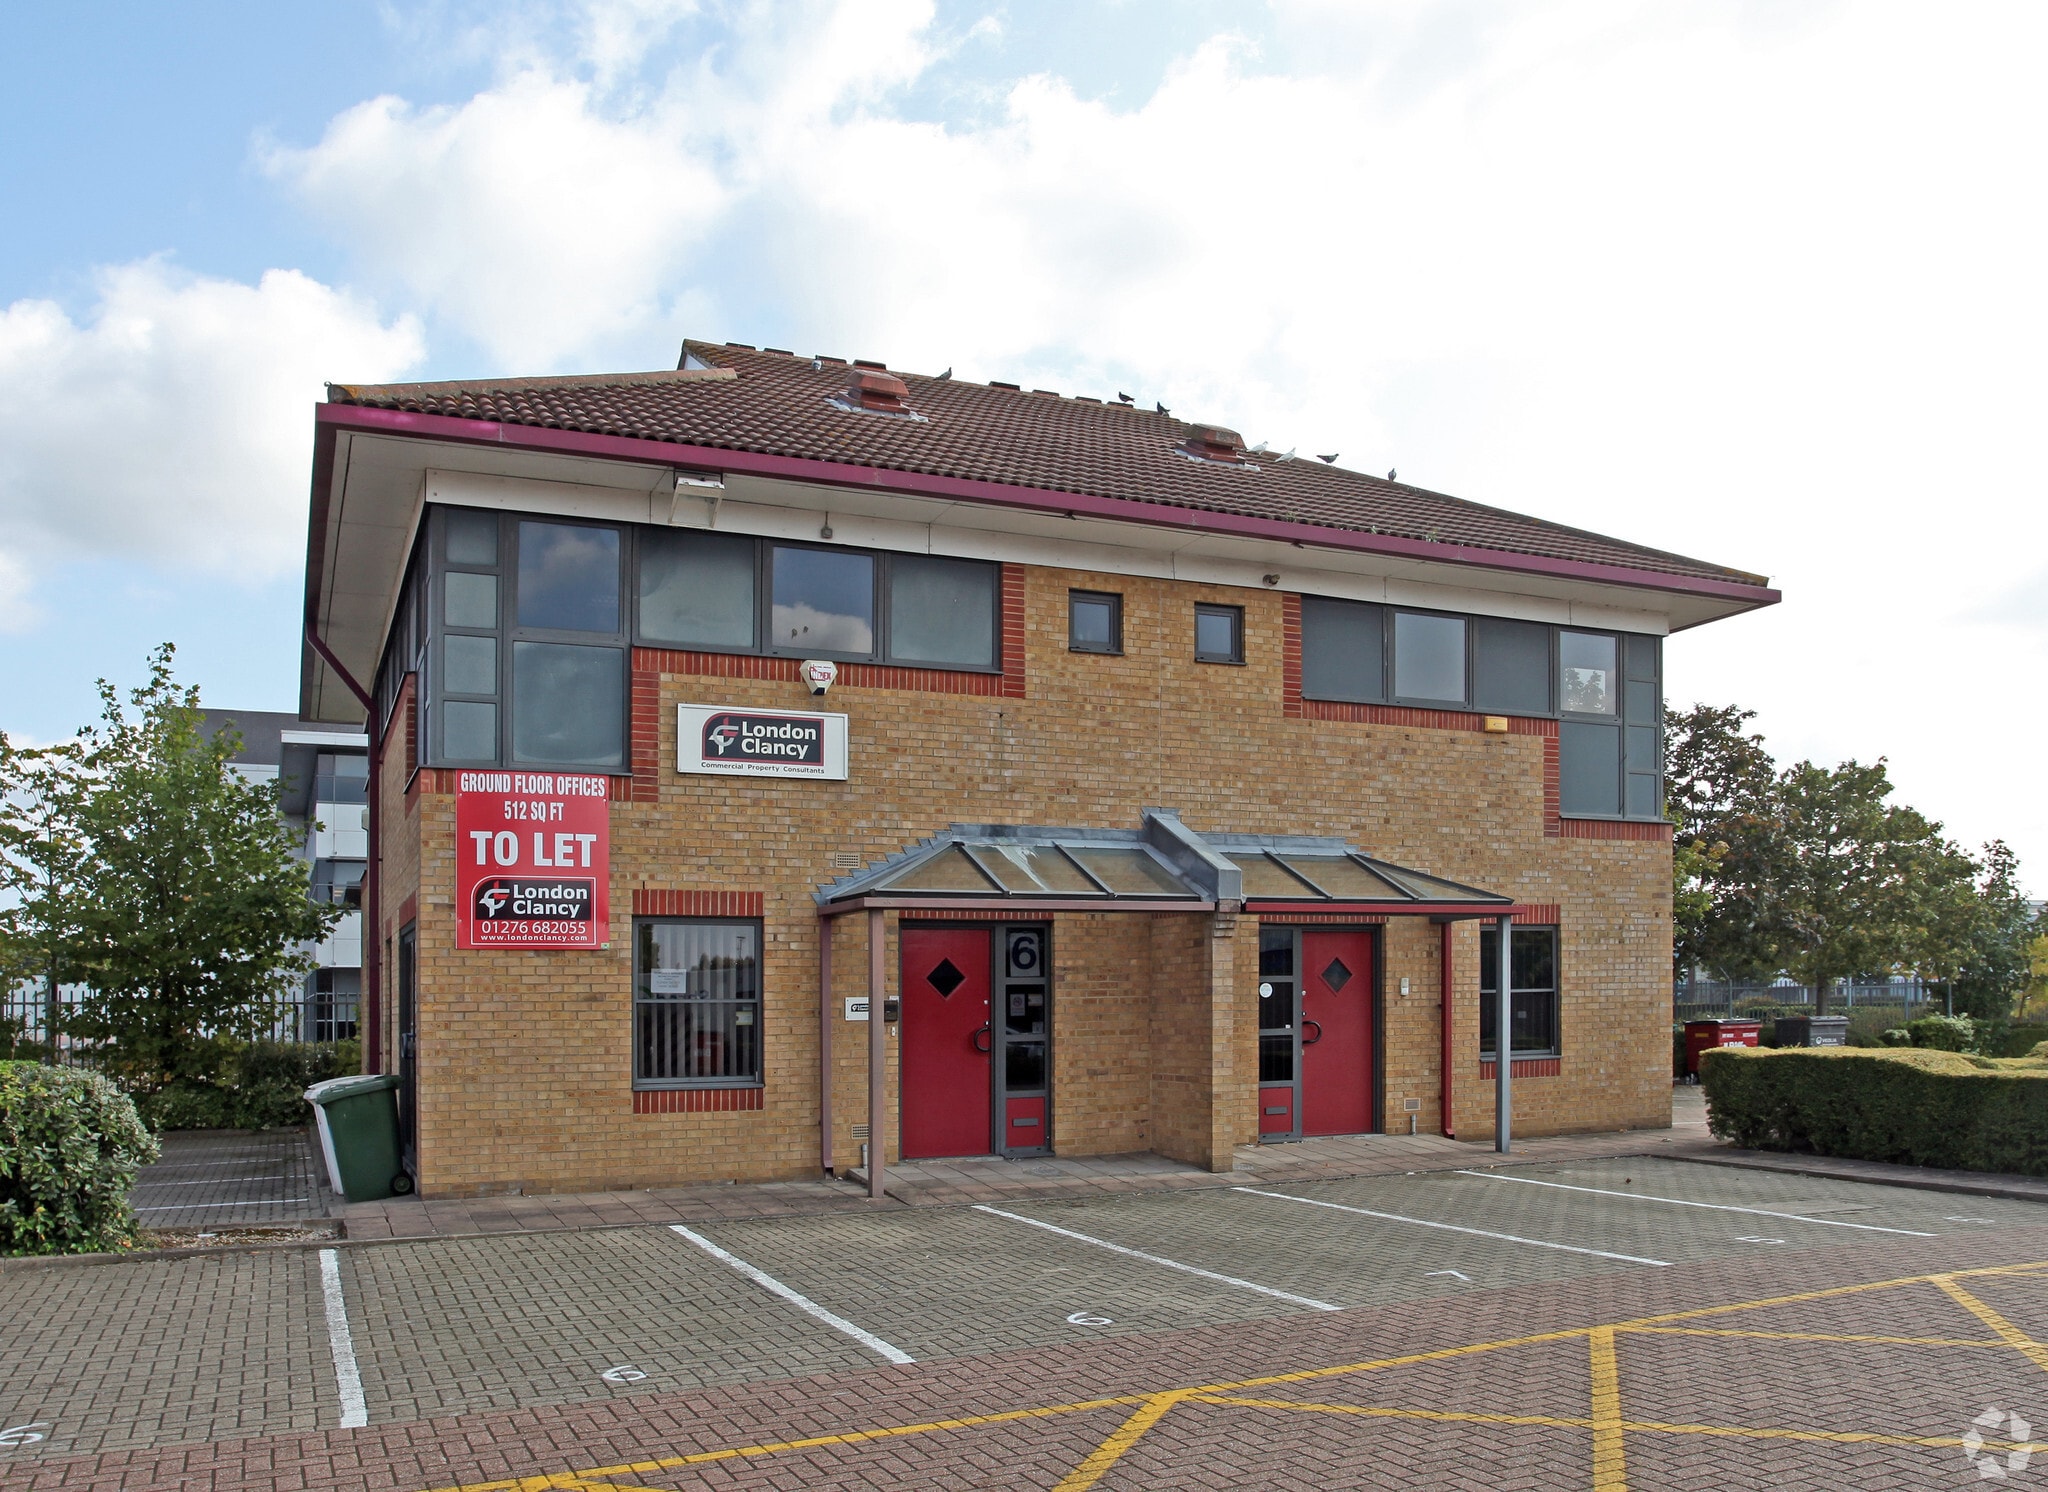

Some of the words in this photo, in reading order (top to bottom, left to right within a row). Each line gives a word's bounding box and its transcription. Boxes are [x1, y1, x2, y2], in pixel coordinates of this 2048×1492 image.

[742, 721, 816, 741] London
[741, 738, 809, 760] Clancy
[701, 761, 744, 770] Commercial
[747, 764, 780, 773] Property
[783, 766, 825, 774] Consultants
[460, 772, 511, 793] GROUND
[514, 774, 553, 795] FLOOR
[556, 776, 605, 797] OFFICES
[504, 800, 527, 820] 512
[530, 801, 546, 822] SQ
[549, 802, 564, 821] FT
[469, 830, 519, 866] TO
[533, 832, 597, 867] LET
[513, 884, 588, 900] London
[512, 900, 580, 919] Clancy
[481, 920, 529, 934] 01276
[532, 921, 586, 934] 682055
[480, 934, 588, 942] www.londonclancy.com
[1011, 935, 1037, 971] 6
[1067, 1311, 1114, 1326] 6
[602, 1364, 648, 1381] 6
